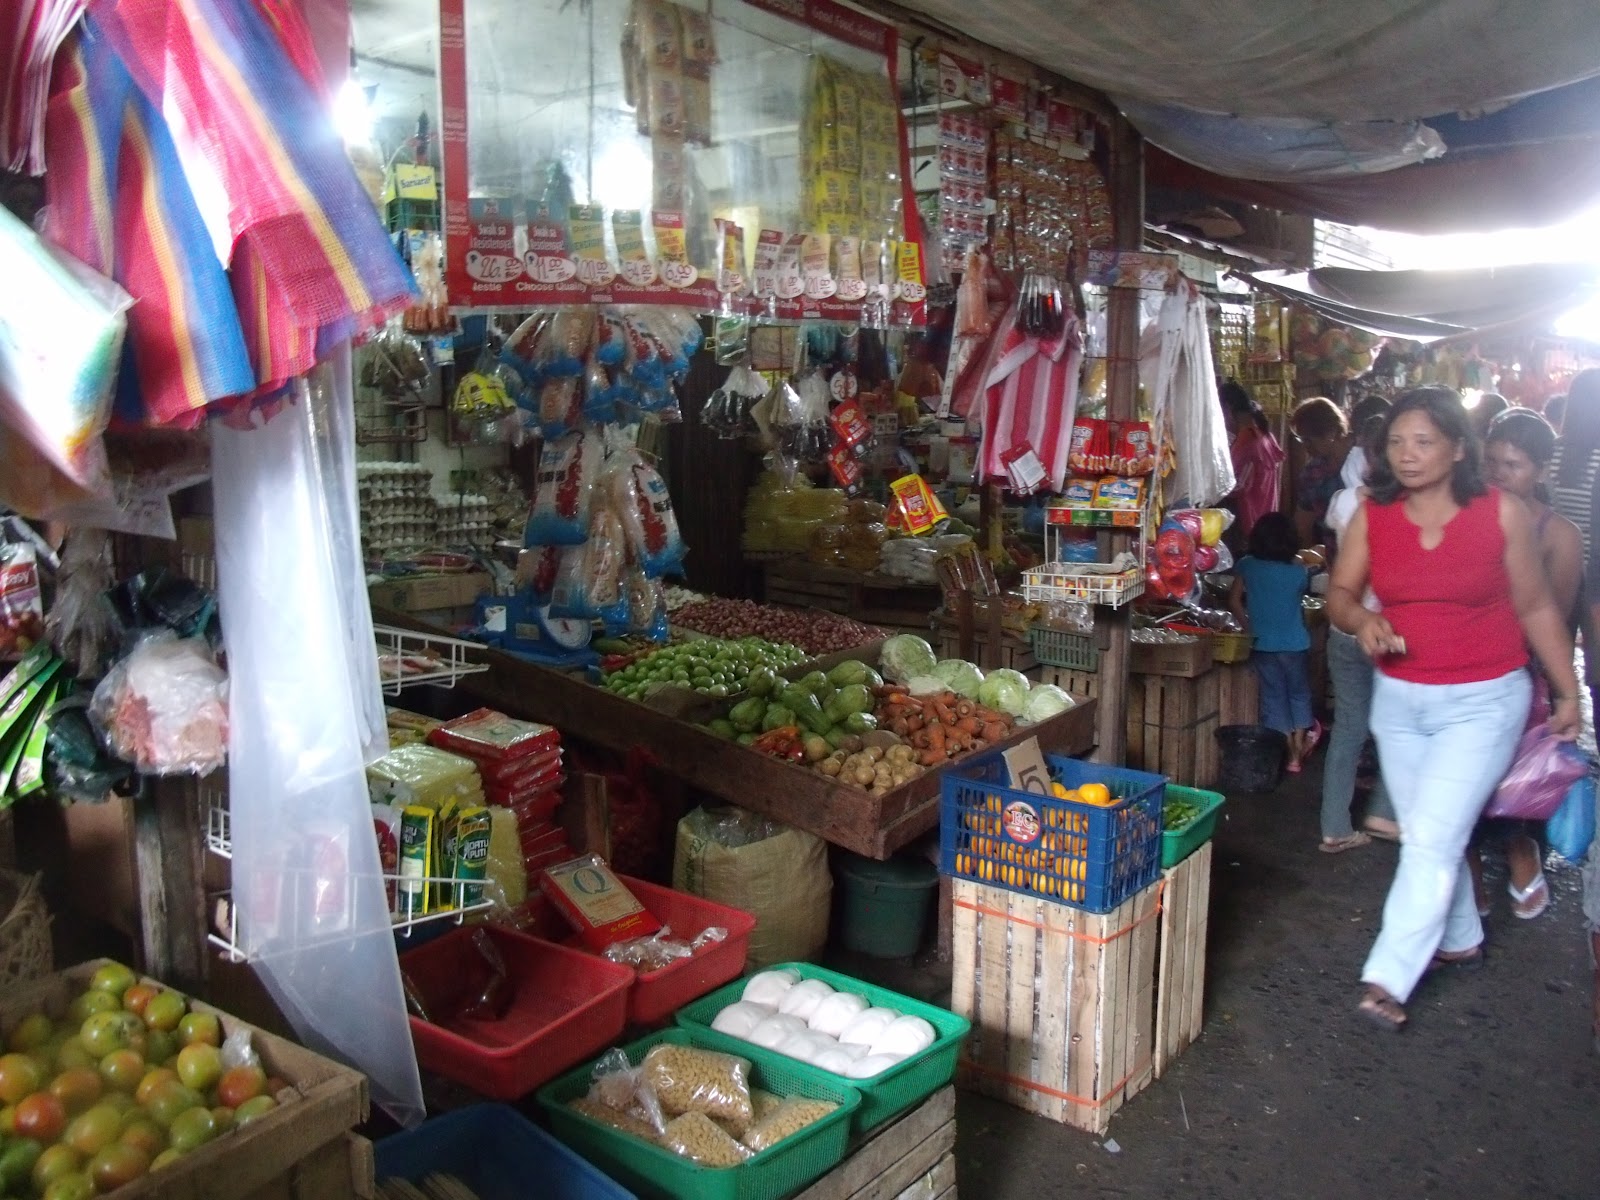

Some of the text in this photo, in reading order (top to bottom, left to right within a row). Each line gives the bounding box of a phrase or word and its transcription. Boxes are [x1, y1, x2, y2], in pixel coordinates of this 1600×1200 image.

[515, 282, 554, 292] Choose
[470, 849, 487, 858] PUTI
[572, 867, 612, 894] Q
